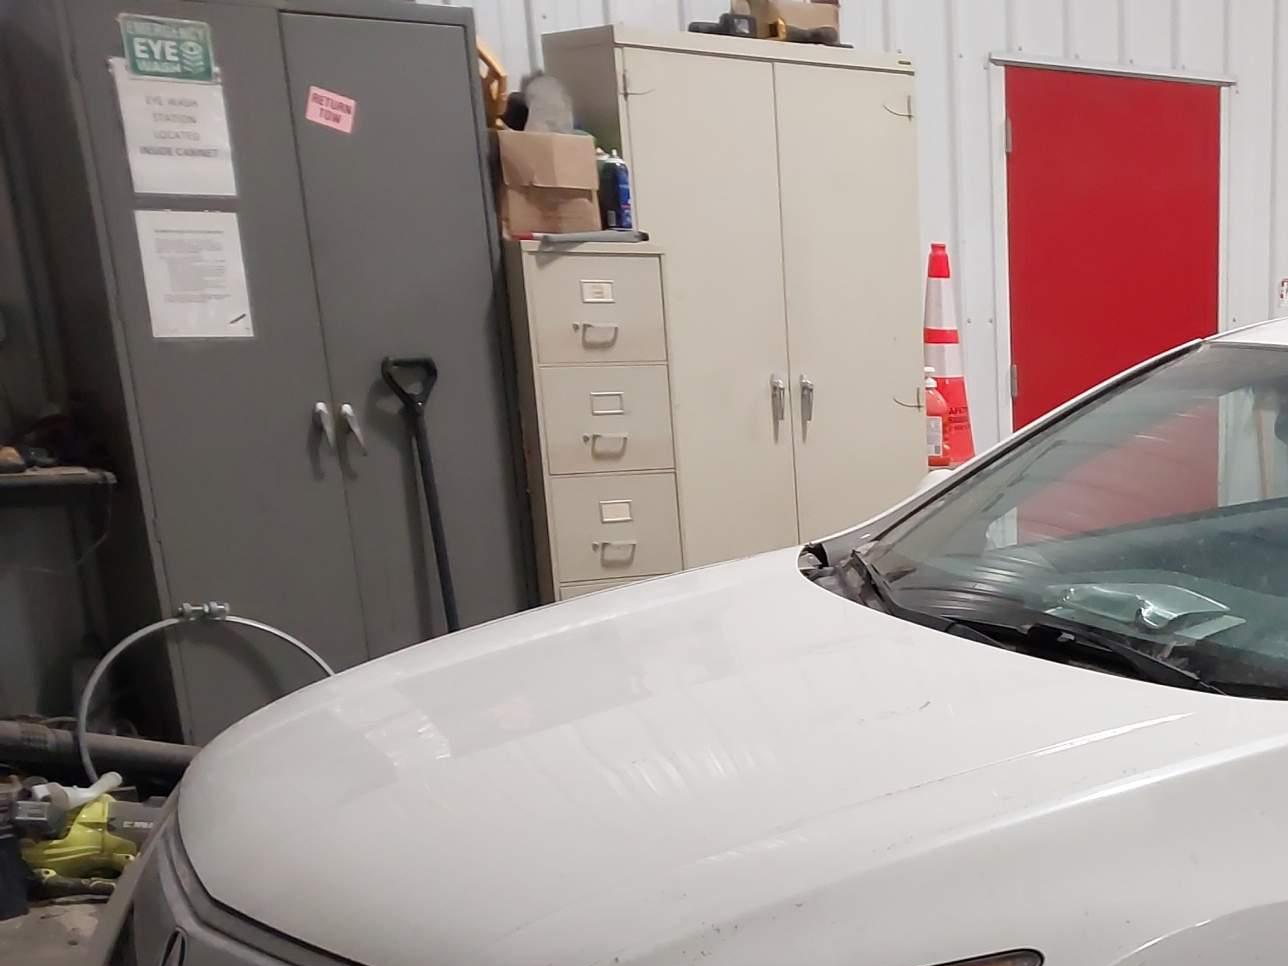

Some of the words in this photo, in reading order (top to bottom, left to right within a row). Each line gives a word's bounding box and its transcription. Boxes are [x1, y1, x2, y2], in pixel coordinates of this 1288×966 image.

[133, 37, 181, 61] EYE
[311, 92, 353, 115] RETURN
[319, 107, 342, 124] TOW
